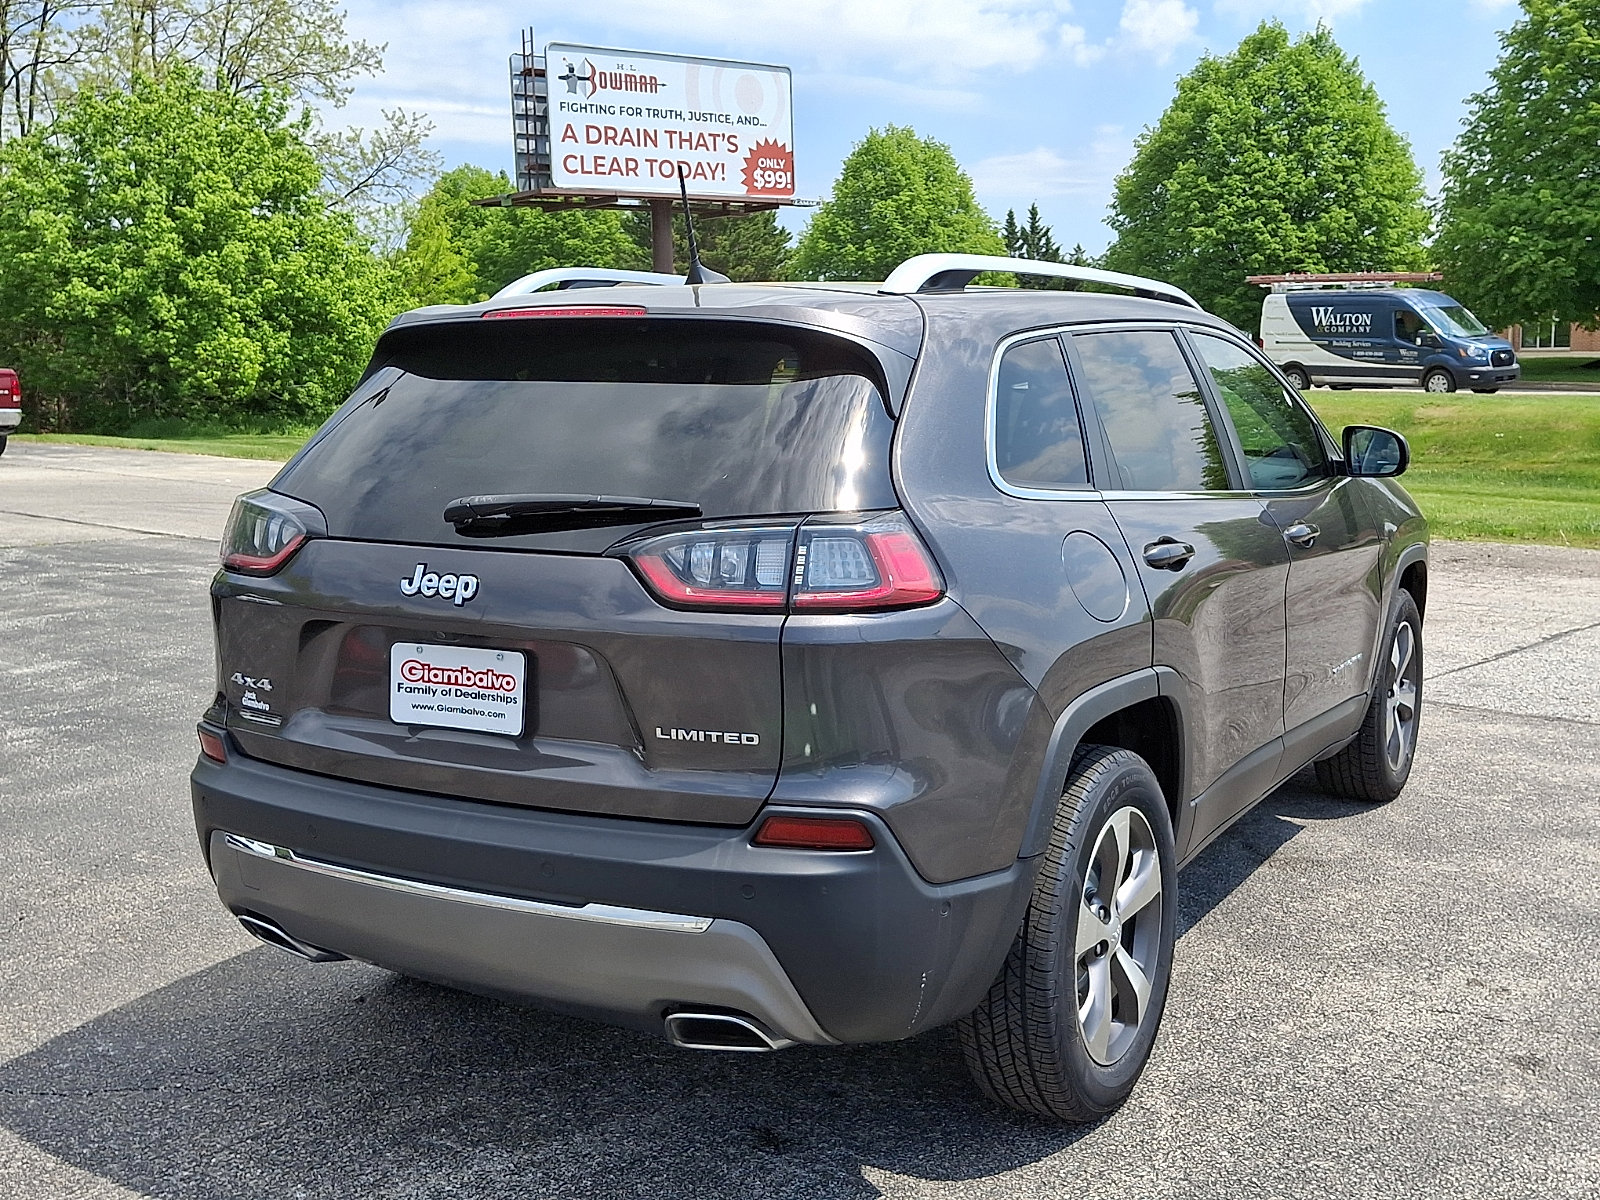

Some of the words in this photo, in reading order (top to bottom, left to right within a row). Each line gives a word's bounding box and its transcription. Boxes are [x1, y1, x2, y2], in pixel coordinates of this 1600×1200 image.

[559, 101, 616, 115] FIGHTING
[619, 106, 643, 117] FOR
[645, 108, 686, 122] TRUTH,
[688, 111, 734, 126] JUSTICE,
[736, 115, 767, 127] AND...
[561, 123, 579, 143] A
[585, 125, 658, 148] DRAIN
[664, 130, 739, 153] THAT'S
[563, 154, 639, 177] CLEAR
[645, 158, 726, 181] TODAY!
[758, 158, 786, 169] ONLY
[753, 167, 792, 190] $99!
[1310, 306, 1373, 327] WALTON
[1324, 325, 1371, 333] COMPANY
[400, 563, 480, 607] Jeep
[231, 672, 273, 691] 4x4
[401, 660, 516, 692] Giambalvo
[397, 682, 438, 698] Family
[440, 688, 452, 697] of
[455, 688, 518, 706] Dealerships
[411, 702, 506, 720] www.Giambalvo.com
[655, 727, 760, 746] LIMITED
